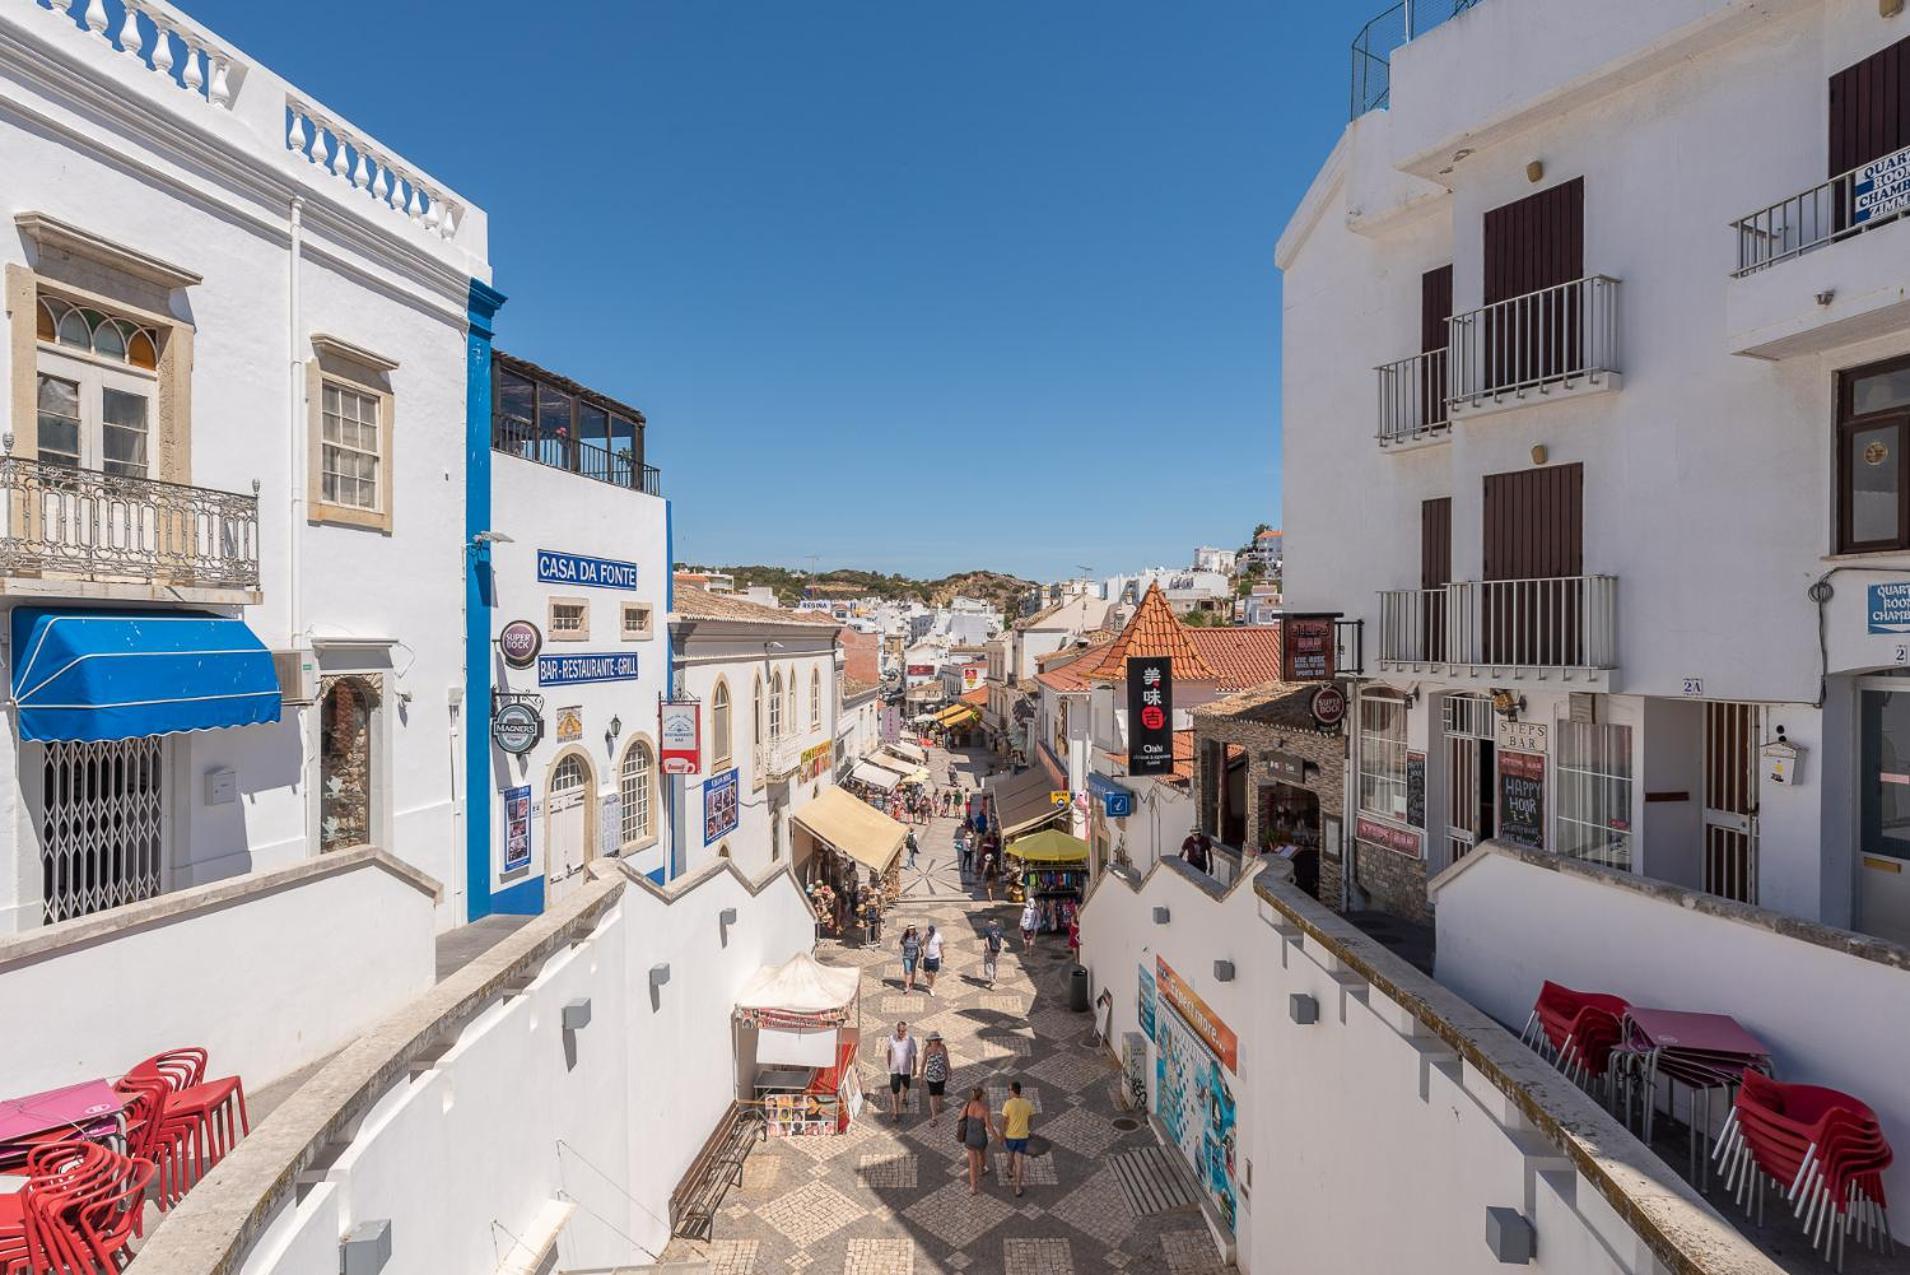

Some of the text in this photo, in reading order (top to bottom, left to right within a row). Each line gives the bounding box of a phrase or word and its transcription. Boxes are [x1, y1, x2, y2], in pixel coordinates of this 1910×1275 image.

[539, 556, 636, 586] CASA DA FONTE
[506, 632, 531, 641] SUPER
[1895, 647, 1905, 661] 2
[1683, 681, 1702, 692] 2A
[496, 724, 535, 734] MAGNERS
[1500, 721, 1546, 737] STEPS
[1509, 735, 1536, 750] BAR
[1505, 778, 1541, 799] HAPPY
[1170, 975, 1194, 1018] Expect
